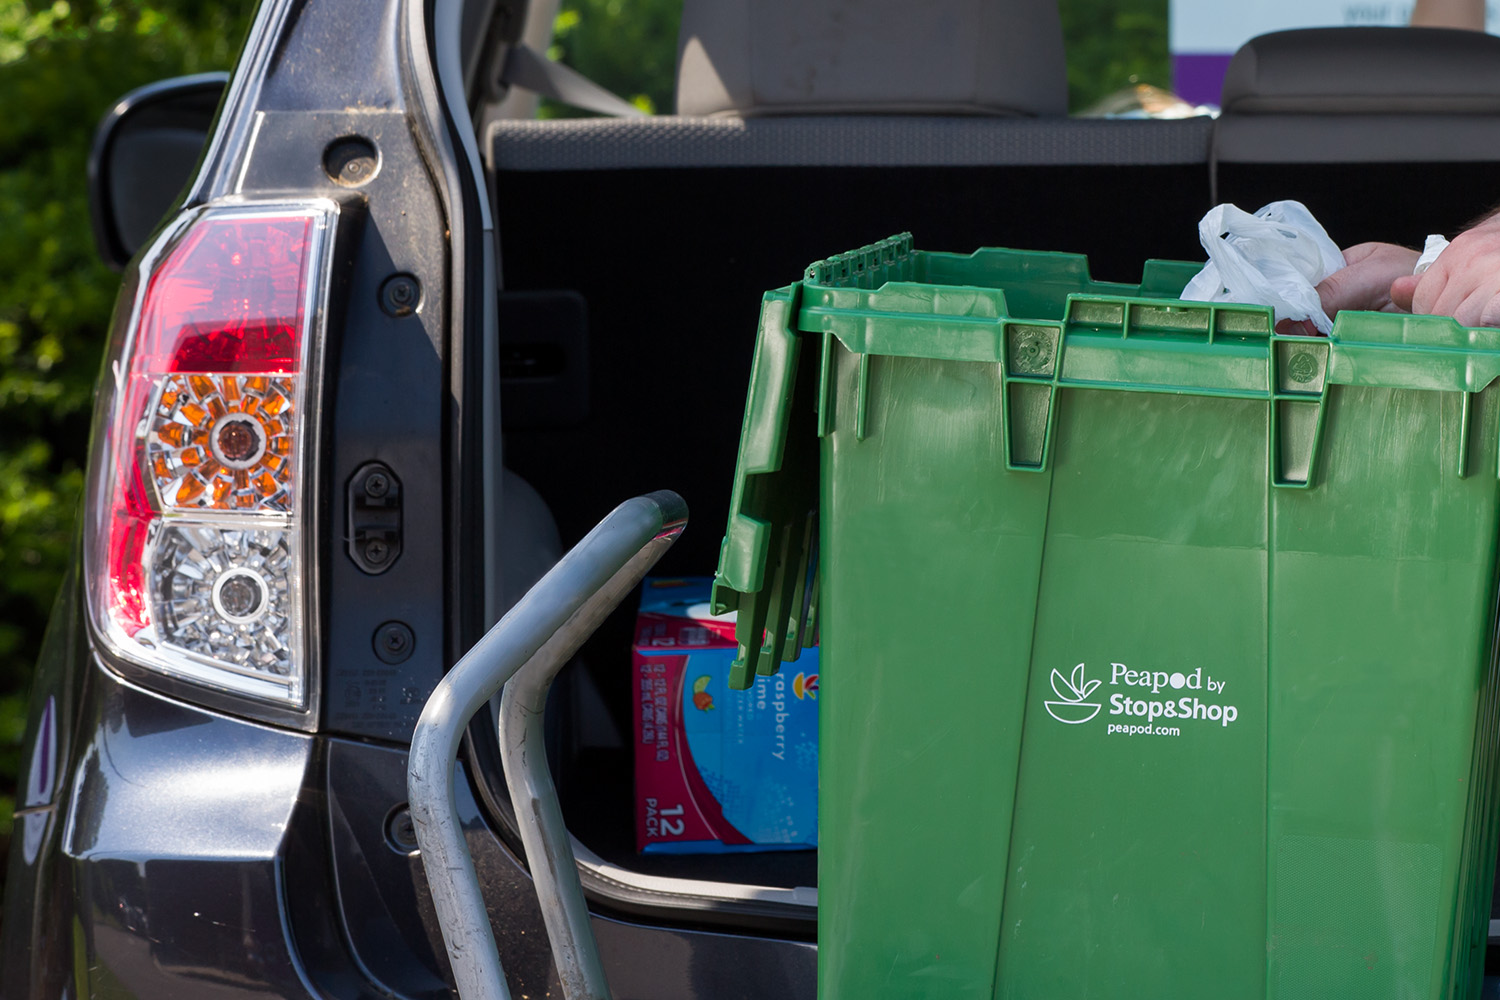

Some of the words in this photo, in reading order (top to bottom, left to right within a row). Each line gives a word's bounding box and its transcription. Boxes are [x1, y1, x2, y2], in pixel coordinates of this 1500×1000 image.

[1109, 662, 1202, 693] Peapod
[1207, 676, 1225, 694] by
[772, 673, 790, 760] raspberry
[1109, 693, 1238, 727] Stop&Shop
[1107, 723, 1180, 736] peapod.com
[645, 798, 658, 837] PACK
[660, 804, 684, 836] 12
